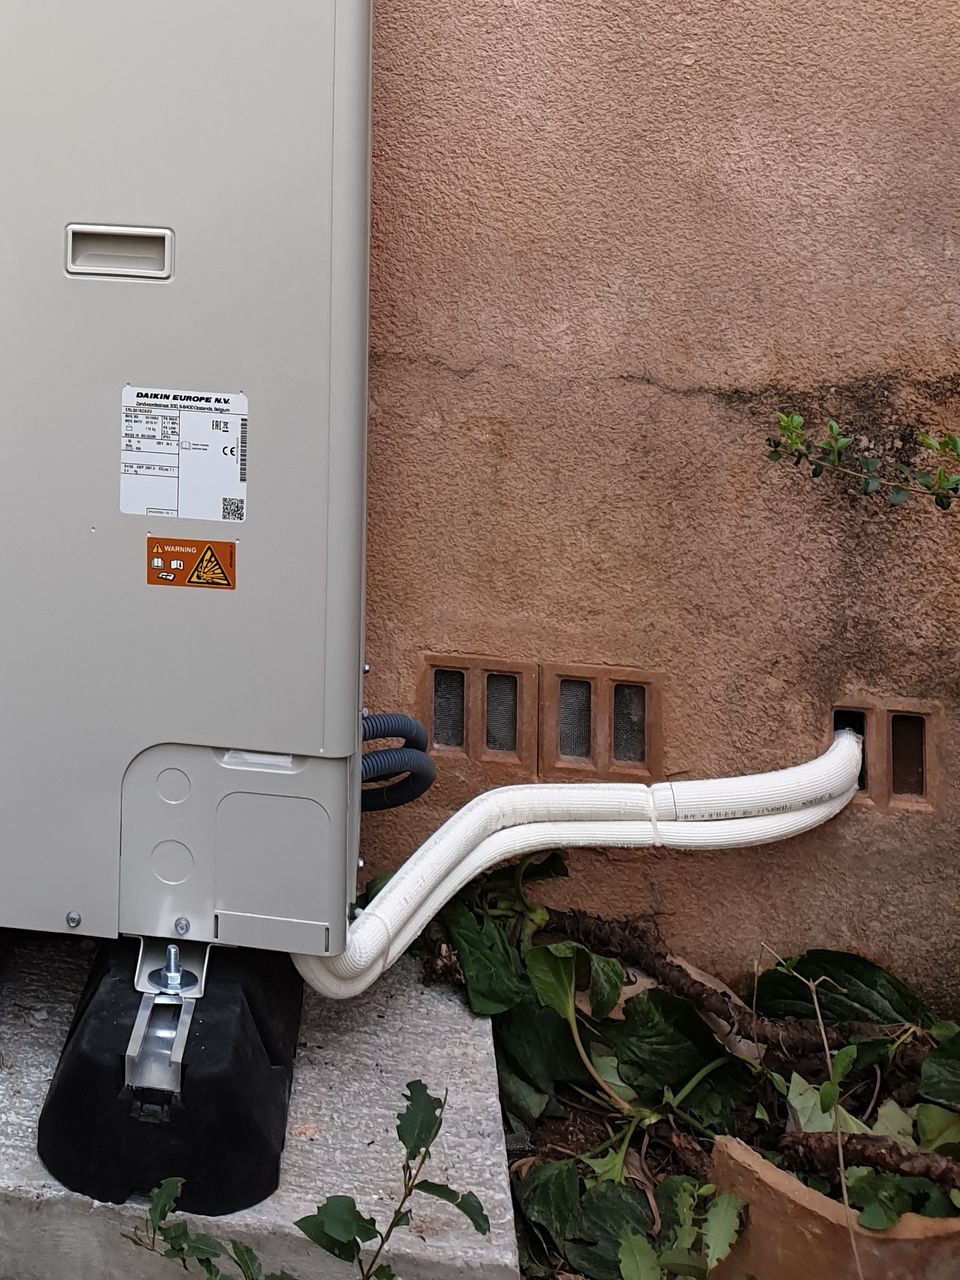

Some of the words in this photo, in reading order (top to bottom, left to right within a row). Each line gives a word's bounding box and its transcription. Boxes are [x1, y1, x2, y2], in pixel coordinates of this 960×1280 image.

[136, 392, 170, 400] DAIKIN
[171, 395, 212, 403] EUROPE
[164, 545, 197, 554] WARNING
